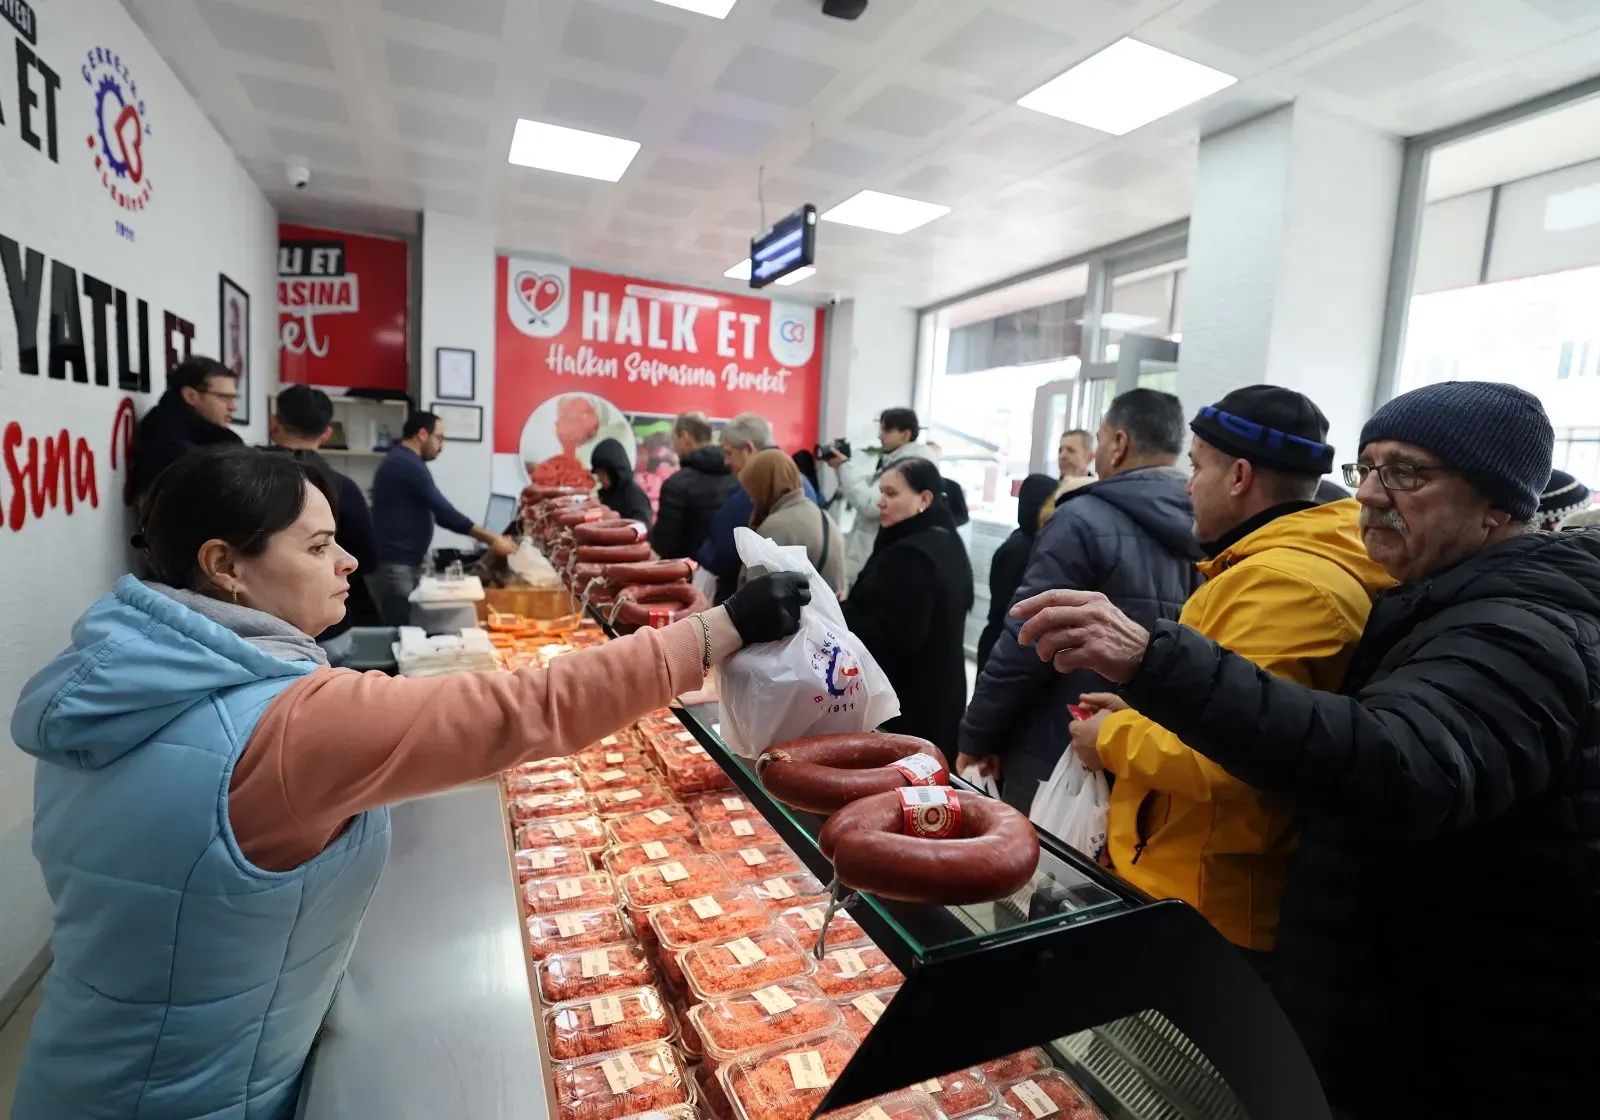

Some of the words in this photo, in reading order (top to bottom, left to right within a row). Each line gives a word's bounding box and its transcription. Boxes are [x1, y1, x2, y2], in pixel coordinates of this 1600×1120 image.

[15, 36, 61, 164] ET
[310, 246, 342, 274] ET
[581, 290, 699, 353] HALK
[716, 309, 762, 360] ET
[545, 342, 619, 380] Halkın
[623, 351, 716, 388] Sofrasına
[721, 362, 793, 395] Bereket
[828, 702, 854, 714] 1911
